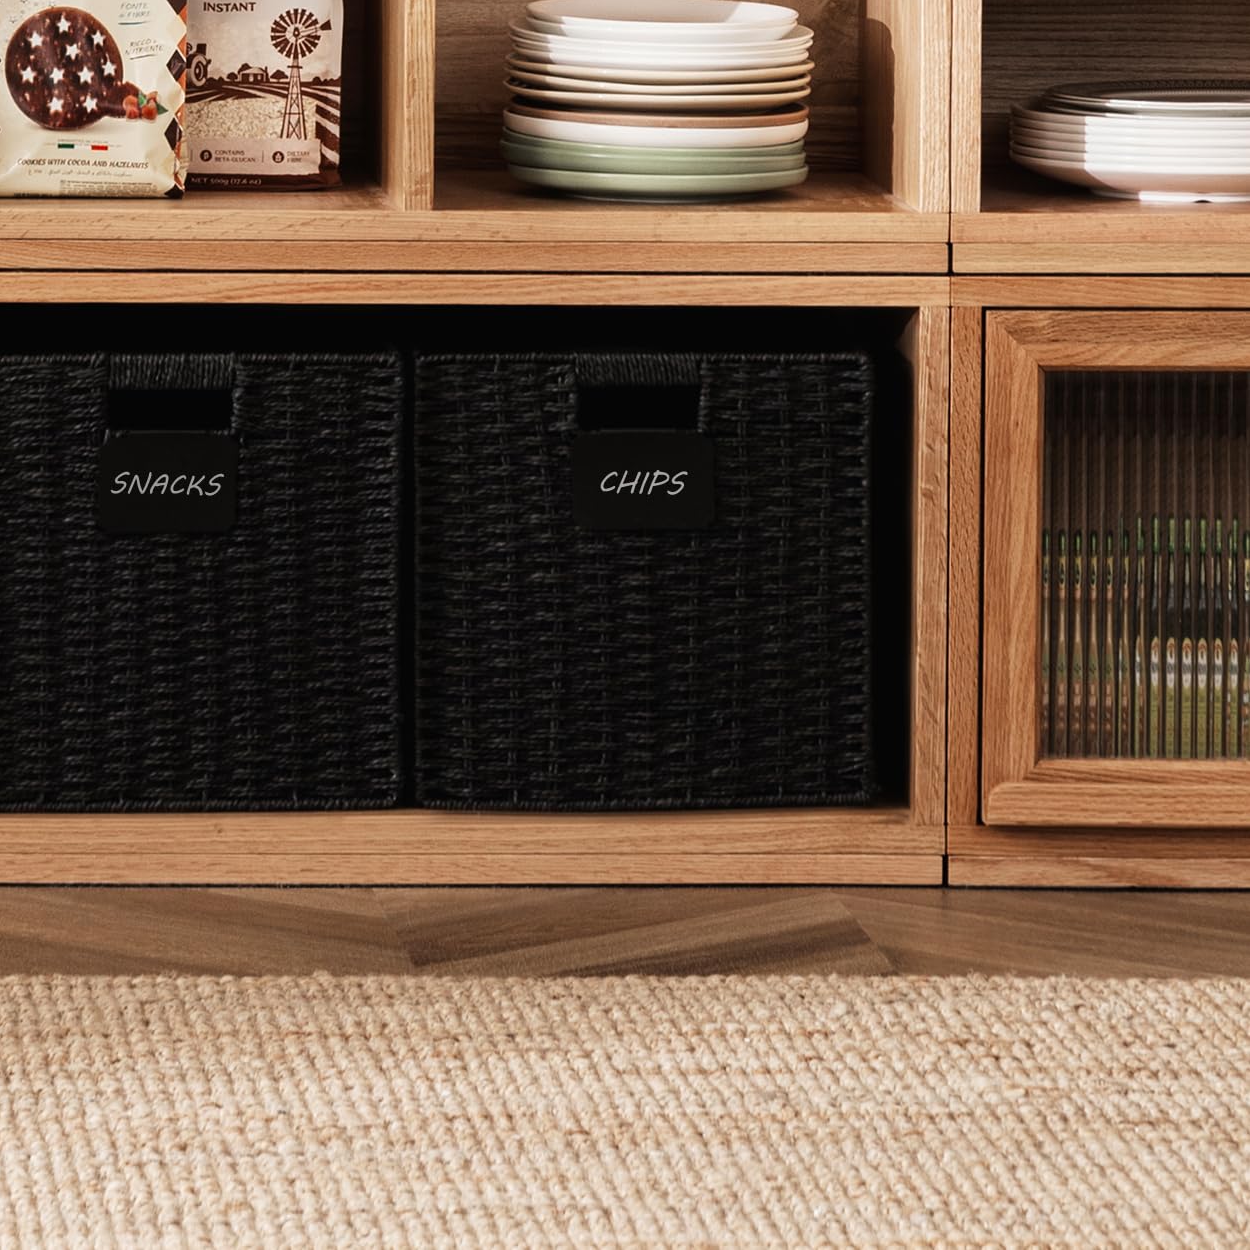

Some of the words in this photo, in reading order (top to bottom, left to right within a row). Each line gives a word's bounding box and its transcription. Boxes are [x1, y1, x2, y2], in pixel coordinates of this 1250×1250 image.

[203, 2, 256, 13] INSTANT
[67, 159, 90, 167] COCOA
[92, 160, 108, 168] AND
[109, 161, 149, 170] HAZELNUTS
[110, 471, 225, 497] SNACKS
[600, 470, 689, 496] CHIPS
